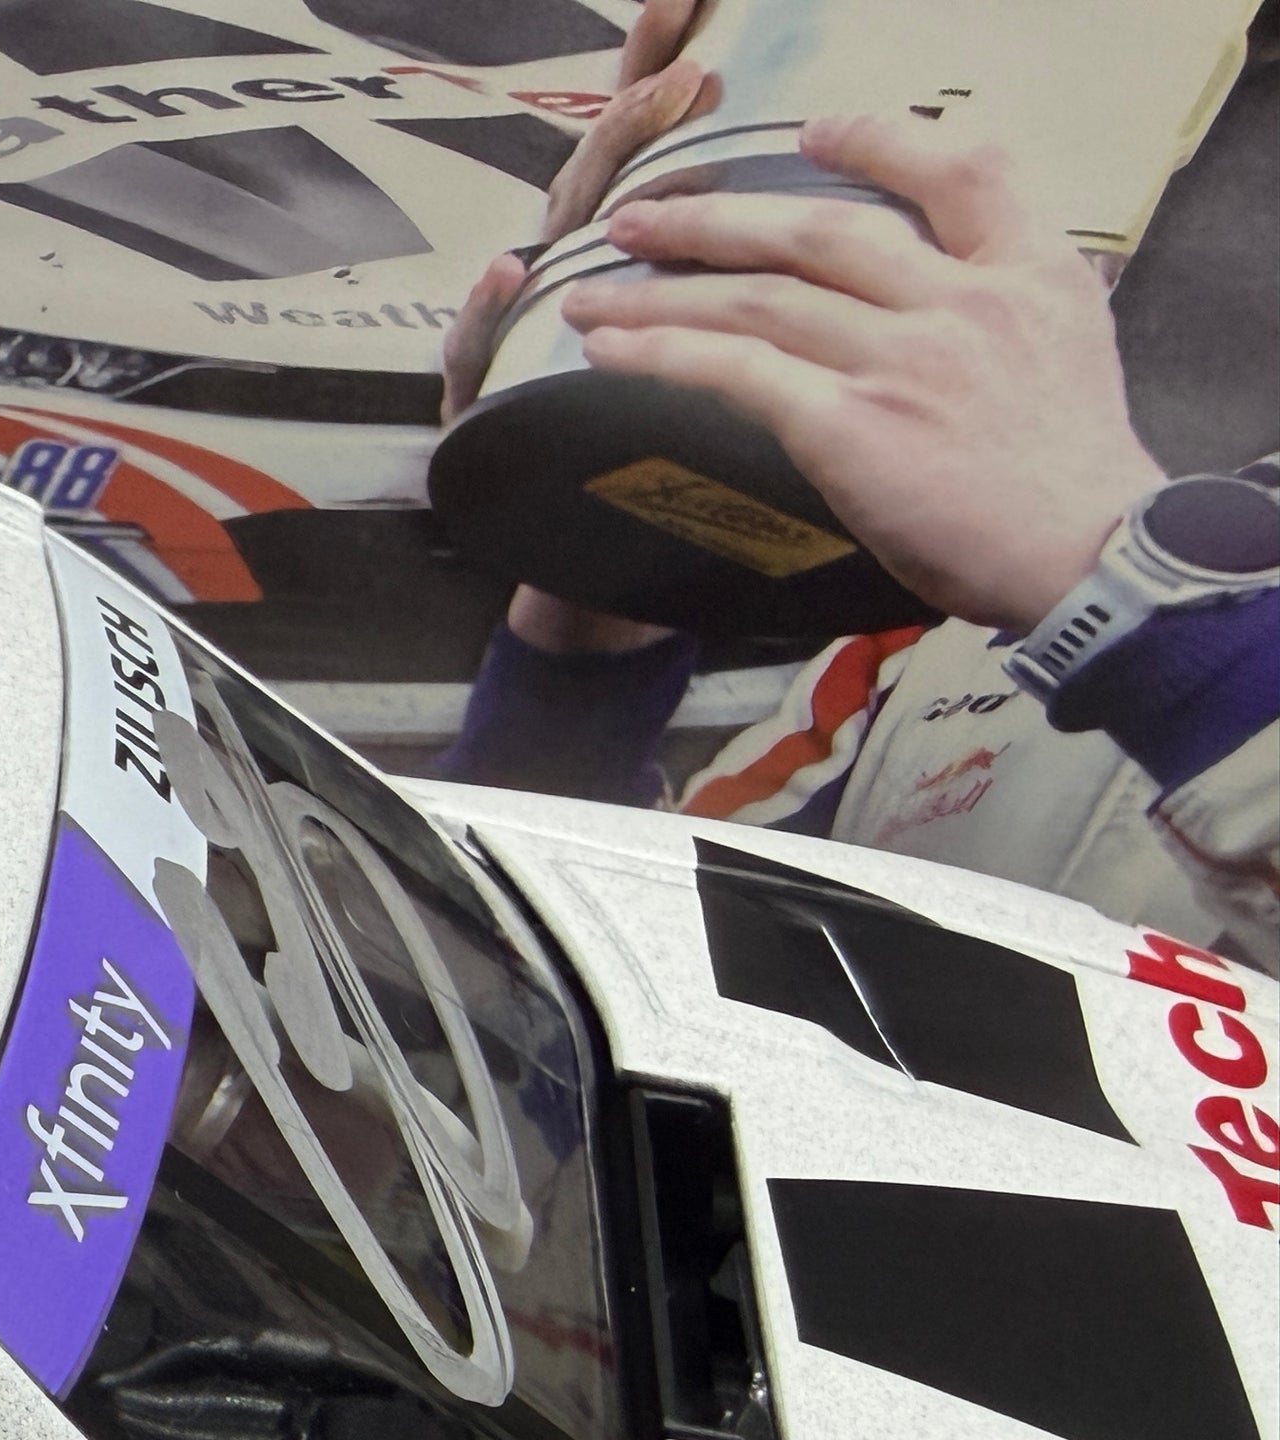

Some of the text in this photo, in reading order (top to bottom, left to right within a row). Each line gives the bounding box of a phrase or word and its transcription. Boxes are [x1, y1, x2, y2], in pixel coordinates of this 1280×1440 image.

[8, 441, 120, 509] 88
[96, 595, 172, 804] ZILISCH
[26, 957, 172, 1242] xfinity
